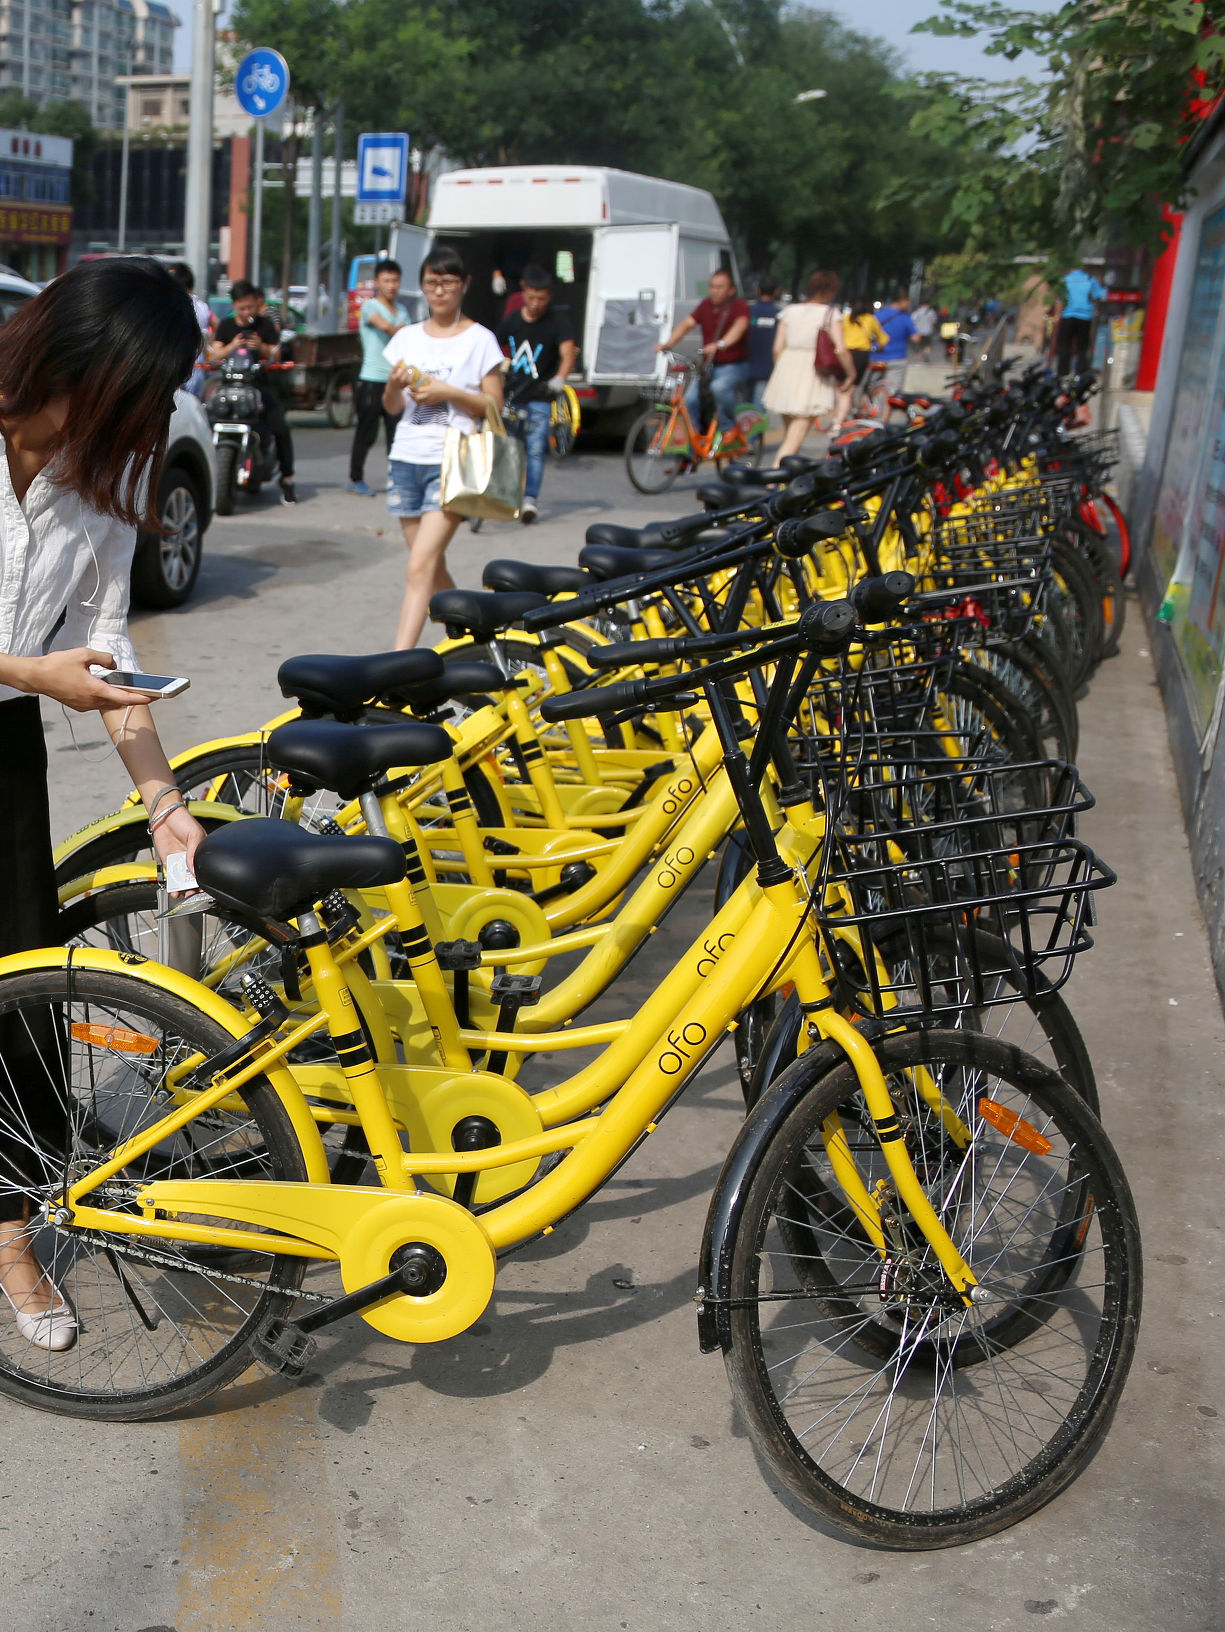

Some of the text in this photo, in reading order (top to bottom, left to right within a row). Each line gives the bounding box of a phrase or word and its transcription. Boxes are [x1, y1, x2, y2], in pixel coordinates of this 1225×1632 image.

[662, 778, 692, 815] ofo
[657, 846, 695, 889] ofo
[697, 932, 736, 978] ofo
[658, 1021, 707, 1075] ofo
